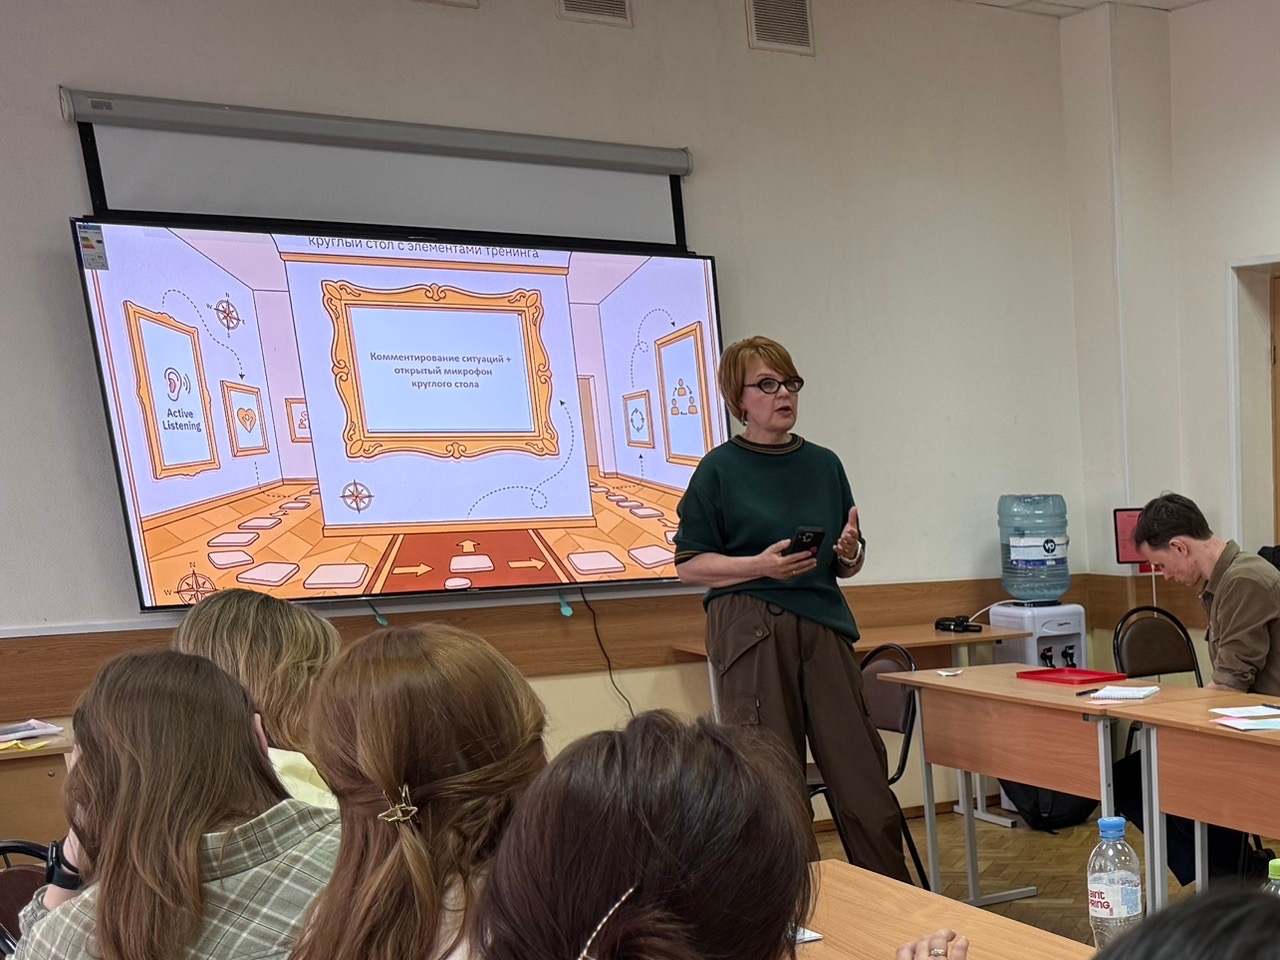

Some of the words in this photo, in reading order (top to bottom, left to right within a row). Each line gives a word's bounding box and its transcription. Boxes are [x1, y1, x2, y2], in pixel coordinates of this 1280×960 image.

[366, 240, 395, 250] стол
[398, 241, 405, 251] с
[408, 242, 482, 255] элементами
[485, 247, 540, 258] тренинга
[370, 352, 460, 363] Комментирование
[462, 355, 504, 364] ситуаций
[394, 366, 442, 376] открытый
[443, 367, 493, 377] микрофон
[411, 381, 452, 389] круглого
[454, 381, 480, 389] стола
[167, 408, 194, 419] Active
[162, 421, 202, 432] Listening
[1089, 889, 1106, 900] aint
[1089, 899, 1111, 909] PRING
